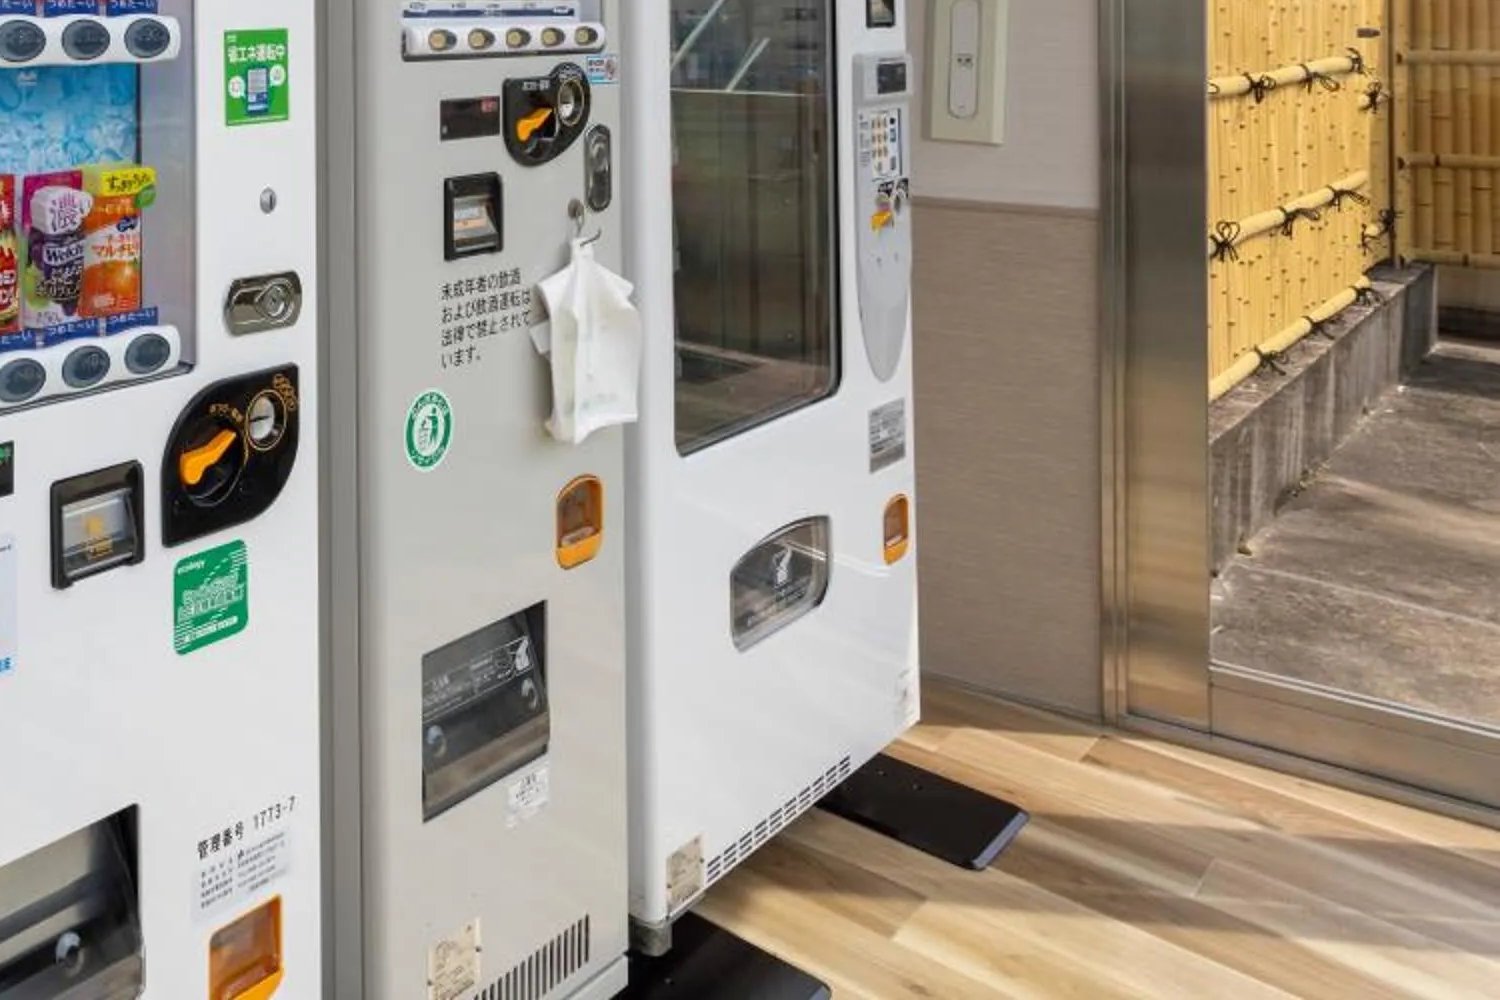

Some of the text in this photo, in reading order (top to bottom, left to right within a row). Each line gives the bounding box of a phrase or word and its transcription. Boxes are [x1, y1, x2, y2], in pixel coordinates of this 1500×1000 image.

[441, 267, 521, 301] 未成年者の飲酒
[441, 287, 531, 325] および飲酒運転は
[441, 310, 532, 348] 法律で禁止されて
[441, 344, 482, 370] います。
[197, 820, 244, 861] 管理番号
